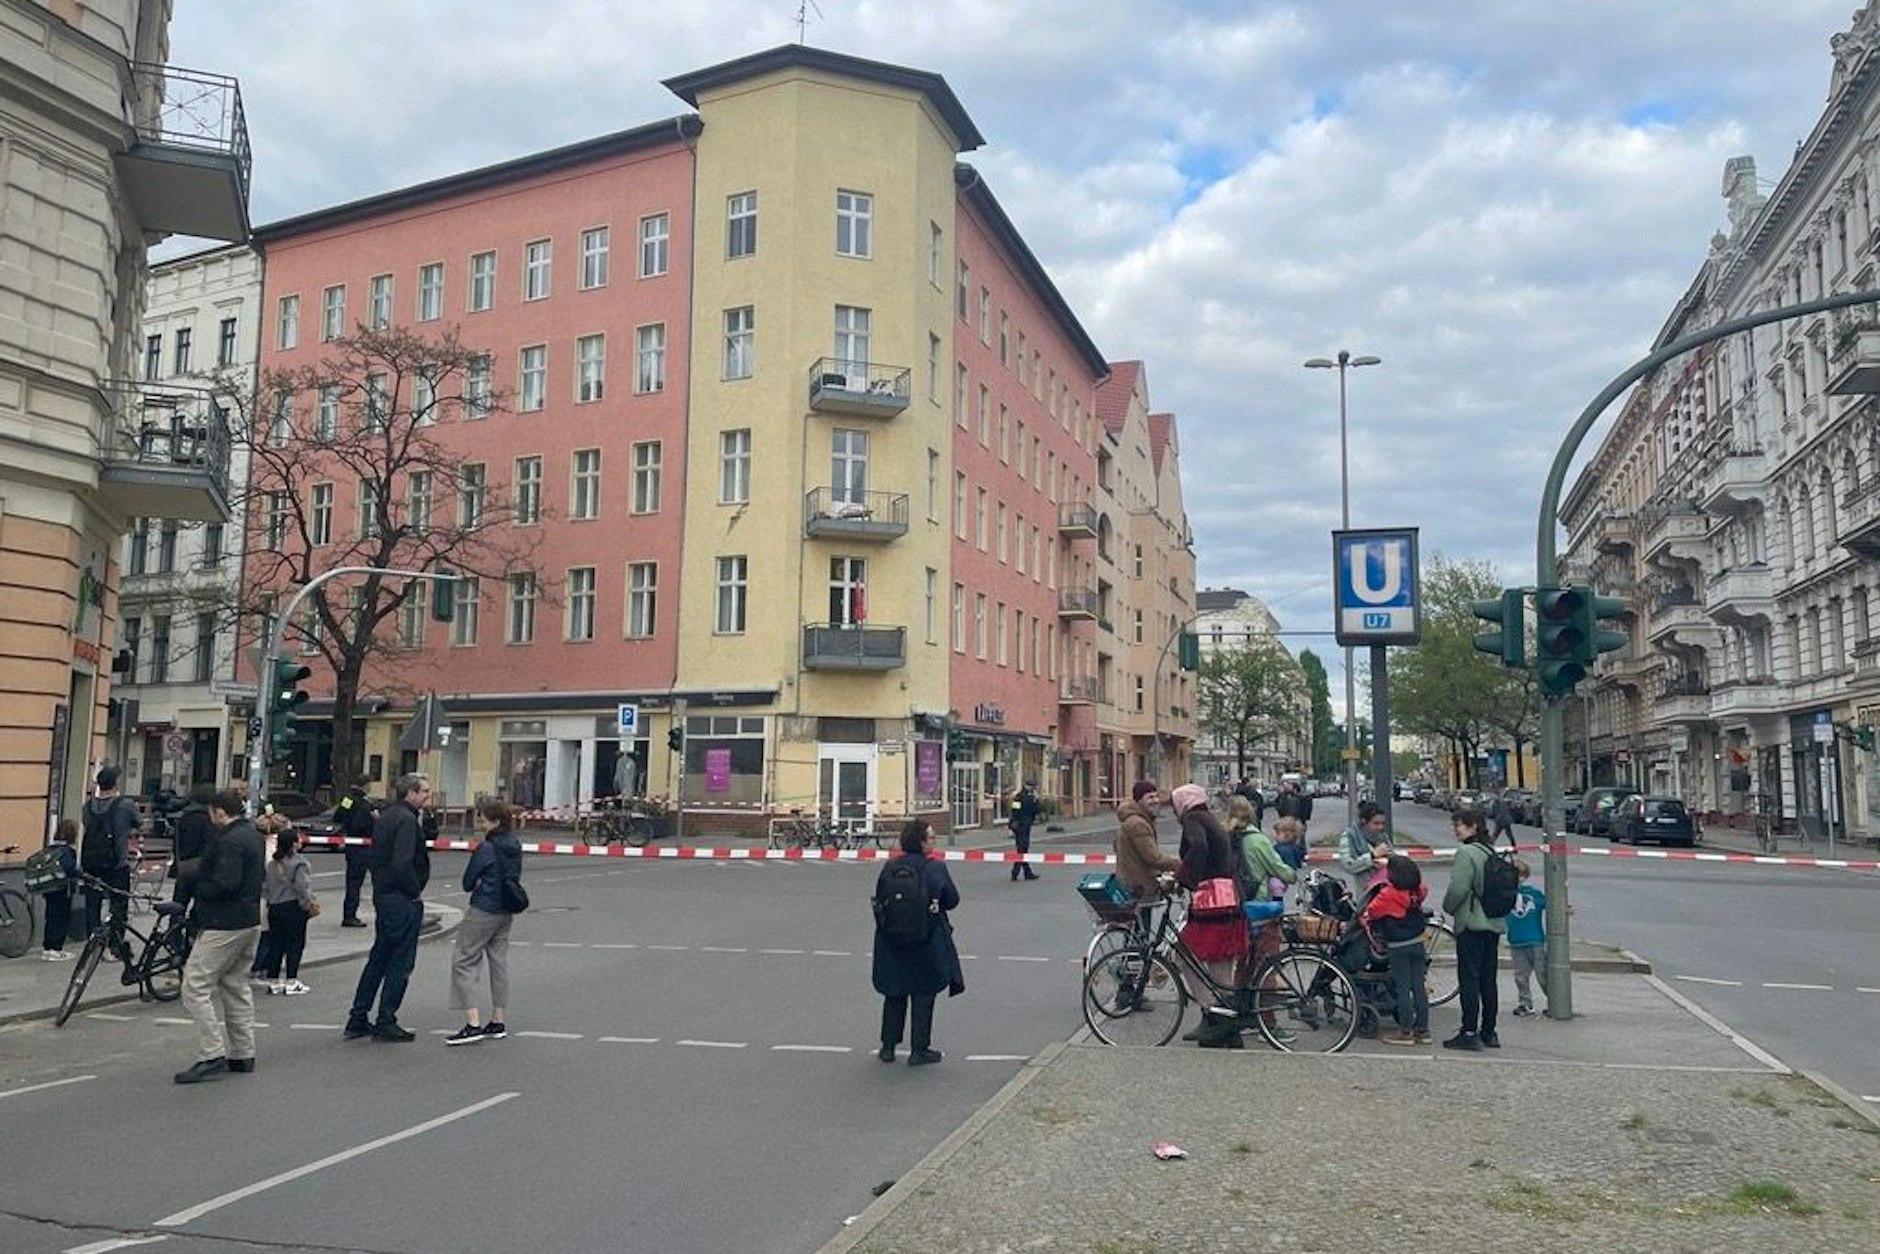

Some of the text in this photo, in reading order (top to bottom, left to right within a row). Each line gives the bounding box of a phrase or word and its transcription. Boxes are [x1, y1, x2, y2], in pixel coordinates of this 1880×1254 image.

[1350, 540, 1401, 604] U
[1366, 614, 1389, 627] U7
[623, 709, 633, 725] P
